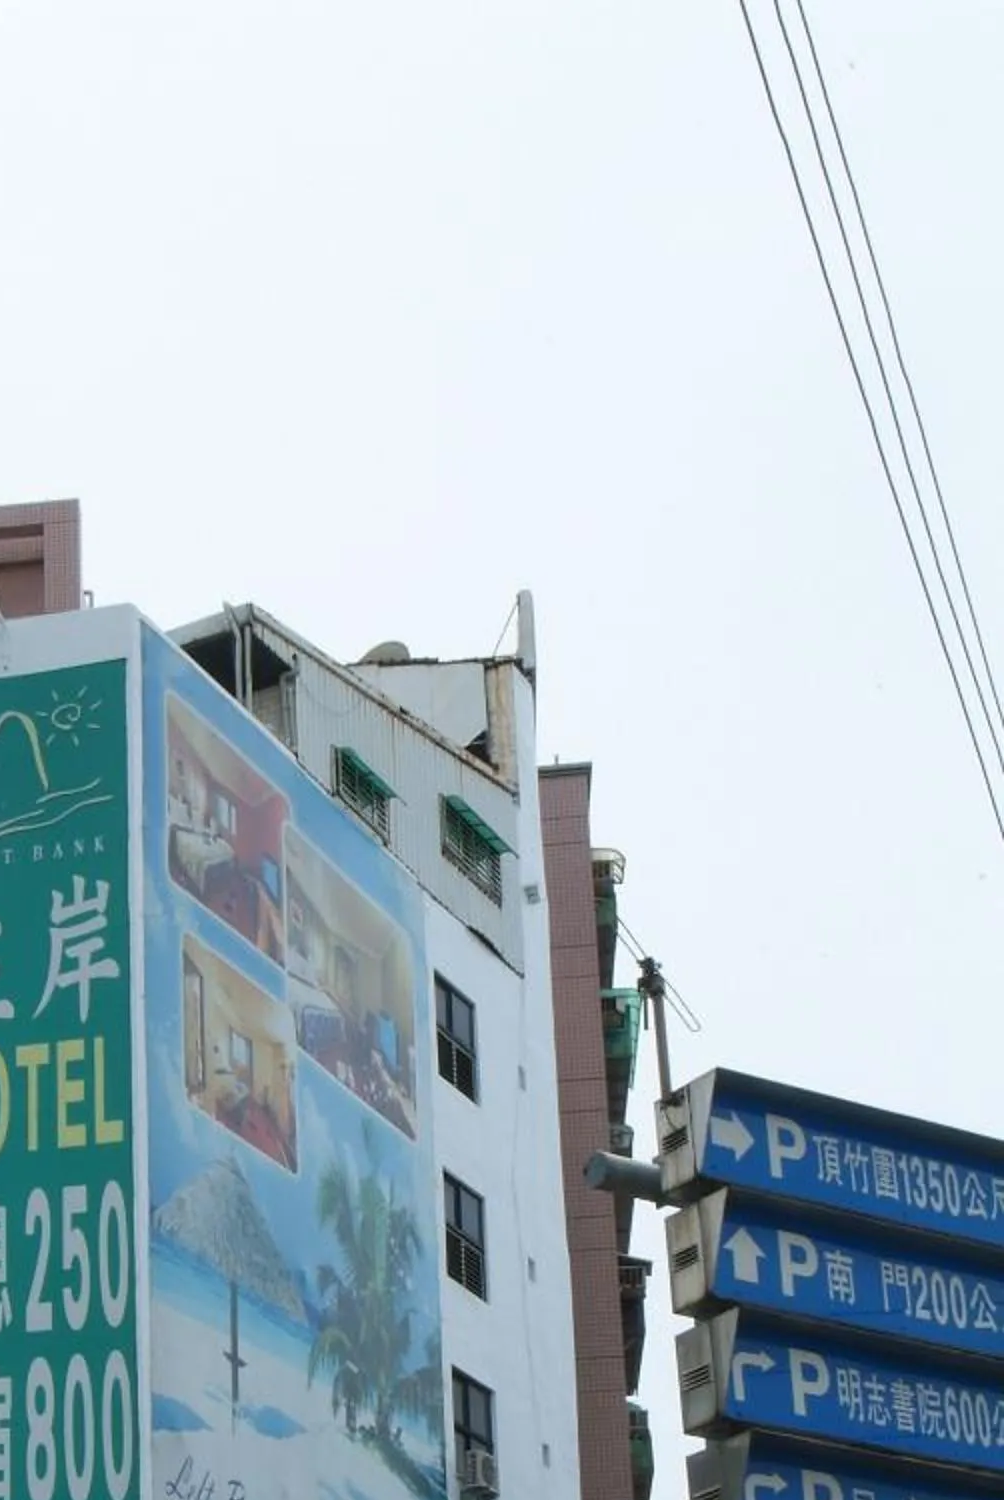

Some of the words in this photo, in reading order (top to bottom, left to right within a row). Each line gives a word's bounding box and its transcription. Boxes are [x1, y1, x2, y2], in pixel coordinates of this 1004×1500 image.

[32, 834, 105, 862] BANK
[765, 1113, 808, 1179] P
[777, 1229, 819, 1297] P
[789, 1347, 831, 1417] P
